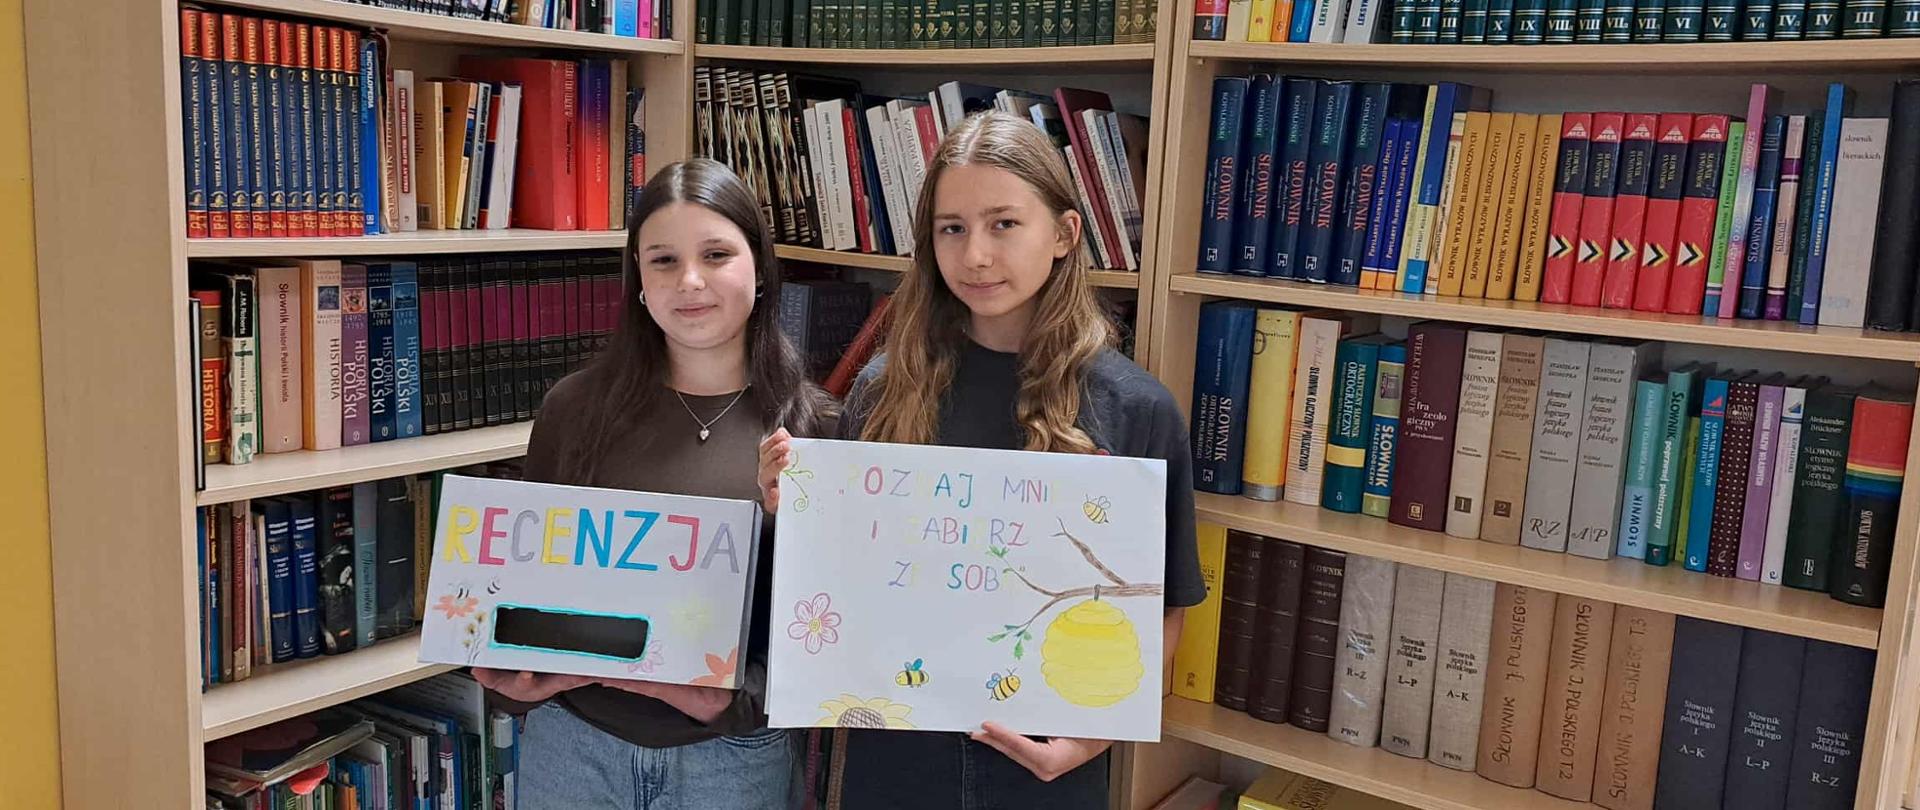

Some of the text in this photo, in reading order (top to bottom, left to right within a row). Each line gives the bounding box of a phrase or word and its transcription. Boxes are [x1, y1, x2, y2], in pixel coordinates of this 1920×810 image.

[1520, 20, 1537, 31] IX
[1676, 18, 1691, 29] VI
[1855, 12, 1875, 23] III
[191, 61, 200, 72] 2
[209, 63, 218, 74] 3
[231, 65, 240, 76] 4
[249, 67, 258, 79] 5
[269, 68, 278, 80] 6
[287, 70, 296, 82] 7
[301, 72, 310, 83] 8
[319, 74, 328, 85] 9
[331, 73, 344, 86] 10
[348, 76, 359, 87] 11
[1217, 157, 1233, 221] SŁOWNIK
[1254, 153, 1272, 218] SŁOWNIK
[1288, 160, 1305, 226] SŁOWNIK
[1317, 162, 1338, 228] SŁOWNIK
[1353, 164, 1375, 231] SŁOWNIK
[1747, 215, 1763, 262] SŁOWNIK
[1447, 245, 1459, 280] SŁOWNIK
[1470, 246, 1482, 280] SŁOWNIK
[1495, 248, 1506, 282] SŁOWNIK
[1523, 249, 1534, 284] SŁOWNIK
[279, 282, 289, 324] Słownik
[330, 337, 340, 400] HISTORIA
[355, 339, 367, 400] HISTORIA
[383, 336, 394, 397] HISTORIA
[407, 336, 418, 395] HISTORIA
[343, 361, 357, 419] POLSKI
[371, 357, 385, 415] POLSKI
[397, 357, 410, 413] POLSKI
[1308, 366, 1320, 397] SŁOWNIK
[203, 369, 214, 432] HISTORIA
[1341, 361, 1357, 439] ORTOGRAFICZNY
[1416, 401, 1429, 411] fra
[1407, 416, 1436, 429] giczny
[1423, 411, 1447, 421] zeolo
[1668, 391, 1684, 440] SŁOWNIK
[1810, 416, 1845, 425] Aleksander
[1214, 397, 1232, 462] SŁOWNIK
[1375, 425, 1394, 488] SŁOWNIK
[1801, 480, 1839, 492] polskiego
[1628, 494, 1643, 547] SŁOWNIK
[443, 504, 740, 574] RECENZJA
[1560, 602, 1592, 758] SŁOWNIK POLSKIEGO
[1684, 700, 1715, 714] Słownik
[1685, 709, 1711, 721] języka
[1748, 711, 1781, 725] Słownik
[1680, 715, 1716, 729] polskiego
[1749, 721, 1776, 732] języka
[1816, 726, 1849, 740] Słownik
[1744, 727, 1782, 741] polskiego
[1818, 735, 1846, 747] języka
[1811, 742, 1851, 756] polskiego
